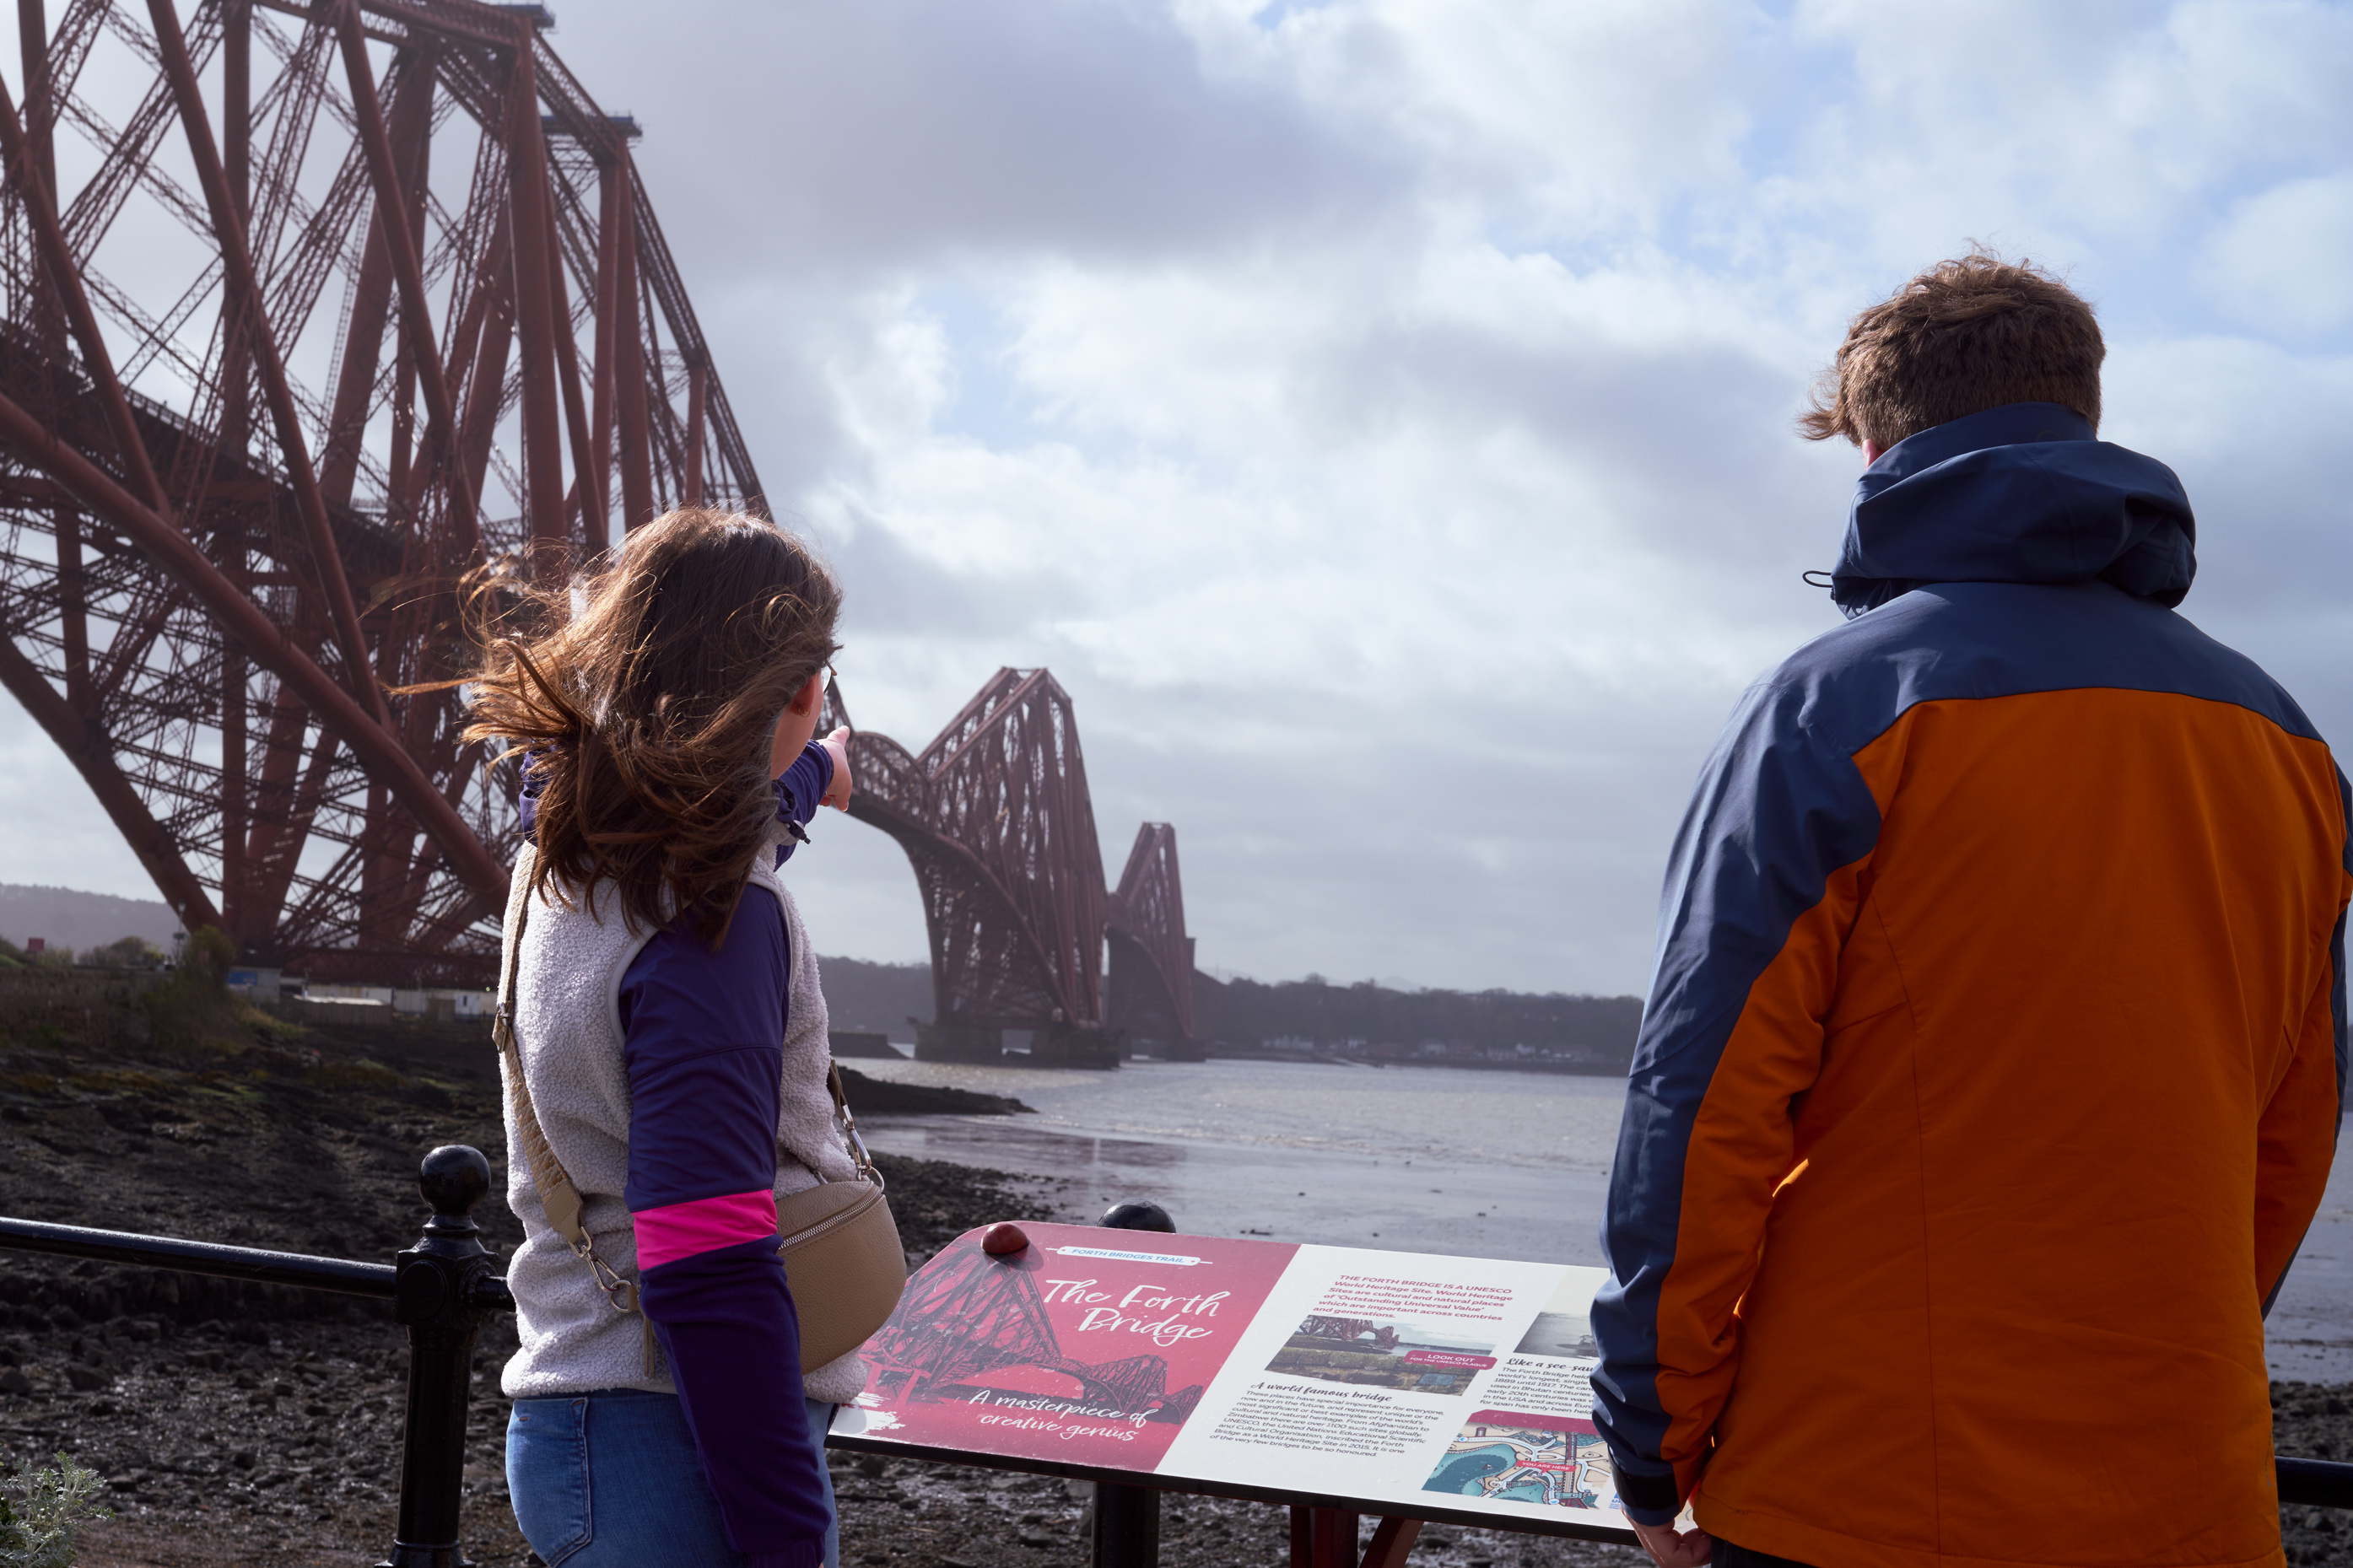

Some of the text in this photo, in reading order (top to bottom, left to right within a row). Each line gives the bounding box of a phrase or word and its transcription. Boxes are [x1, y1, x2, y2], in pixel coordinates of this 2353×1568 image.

[1109, 1252, 1152, 1260] BRIDGES
[1366, 1284, 1409, 1292] Heritage
[1468, 1293, 1513, 1301] Heritage
[1044, 1279, 1231, 1317] The Forth
[1367, 1304, 1418, 1313] important
[1404, 1301, 1452, 1309] Universal
[1333, 1309, 1395, 1318] generations.
[1078, 1308, 1213, 1346] Bridge
[1267, 1384, 1303, 1392] world
[1303, 1387, 1349, 1398] famous
[1352, 1391, 1392, 1402] bridge
[969, 1390, 1158, 1428] A masterpiece of
[1345, 1401, 1391, 1409] importance
[1228, 1412, 1269, 1420] Zimbabwe
[980, 1415, 1137, 1441] creative genius
[1368, 1421, 1419, 1430] Afghanistan
[1224, 1418, 1260, 1426] UNESCO,
[1339, 1430, 1388, 1439] Educational
[1389, 1435, 1426, 1443] Scientific
[1269, 1428, 1323, 1439] Organisation,
[1325, 1435, 1364, 1443] inscribed
[1285, 1436, 1320, 1444] Heritage
[1336, 1448, 1377, 1457] honoured.
